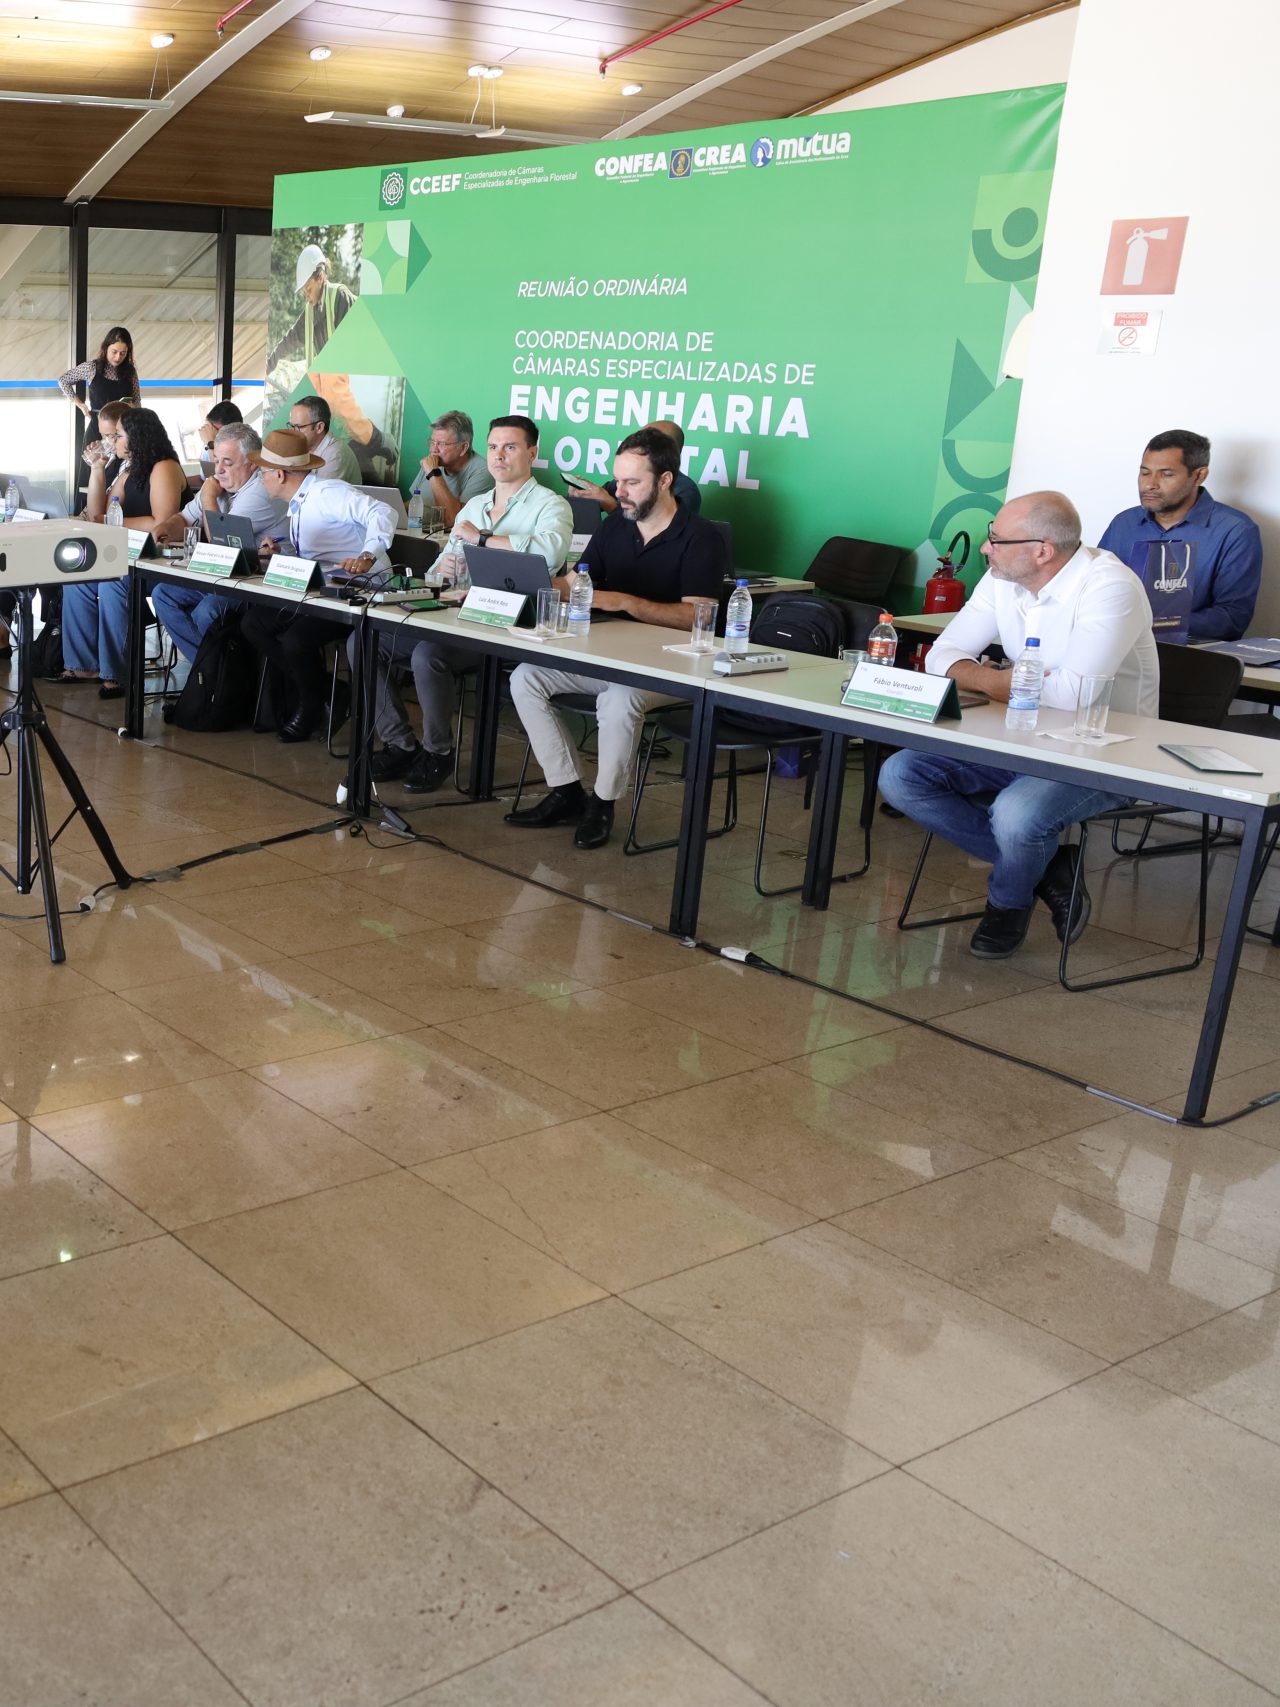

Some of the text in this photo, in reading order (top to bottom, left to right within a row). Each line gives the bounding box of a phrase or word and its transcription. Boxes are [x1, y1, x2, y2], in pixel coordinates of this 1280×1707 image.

[594, 151, 668, 177] CONFEA
[694, 143, 747, 168] CREA
[463, 171, 578, 190] Especializadas de Engenharia Florestal
[464, 165, 544, 180] Coordenadoria de Câmaras
[409, 173, 462, 196] CCEEF
[517, 274, 688, 298] REUNIÃO ORDINÁRIA
[514, 330, 715, 352] COORDENADORIA DE
[512, 352, 817, 386] CÂMARAS ESPECIALIZADAS DE
[508, 384, 810, 439] ENGENHARIA
[873, 677, 892, 687] Fábio
[892, 681, 924, 692] Venturoli
